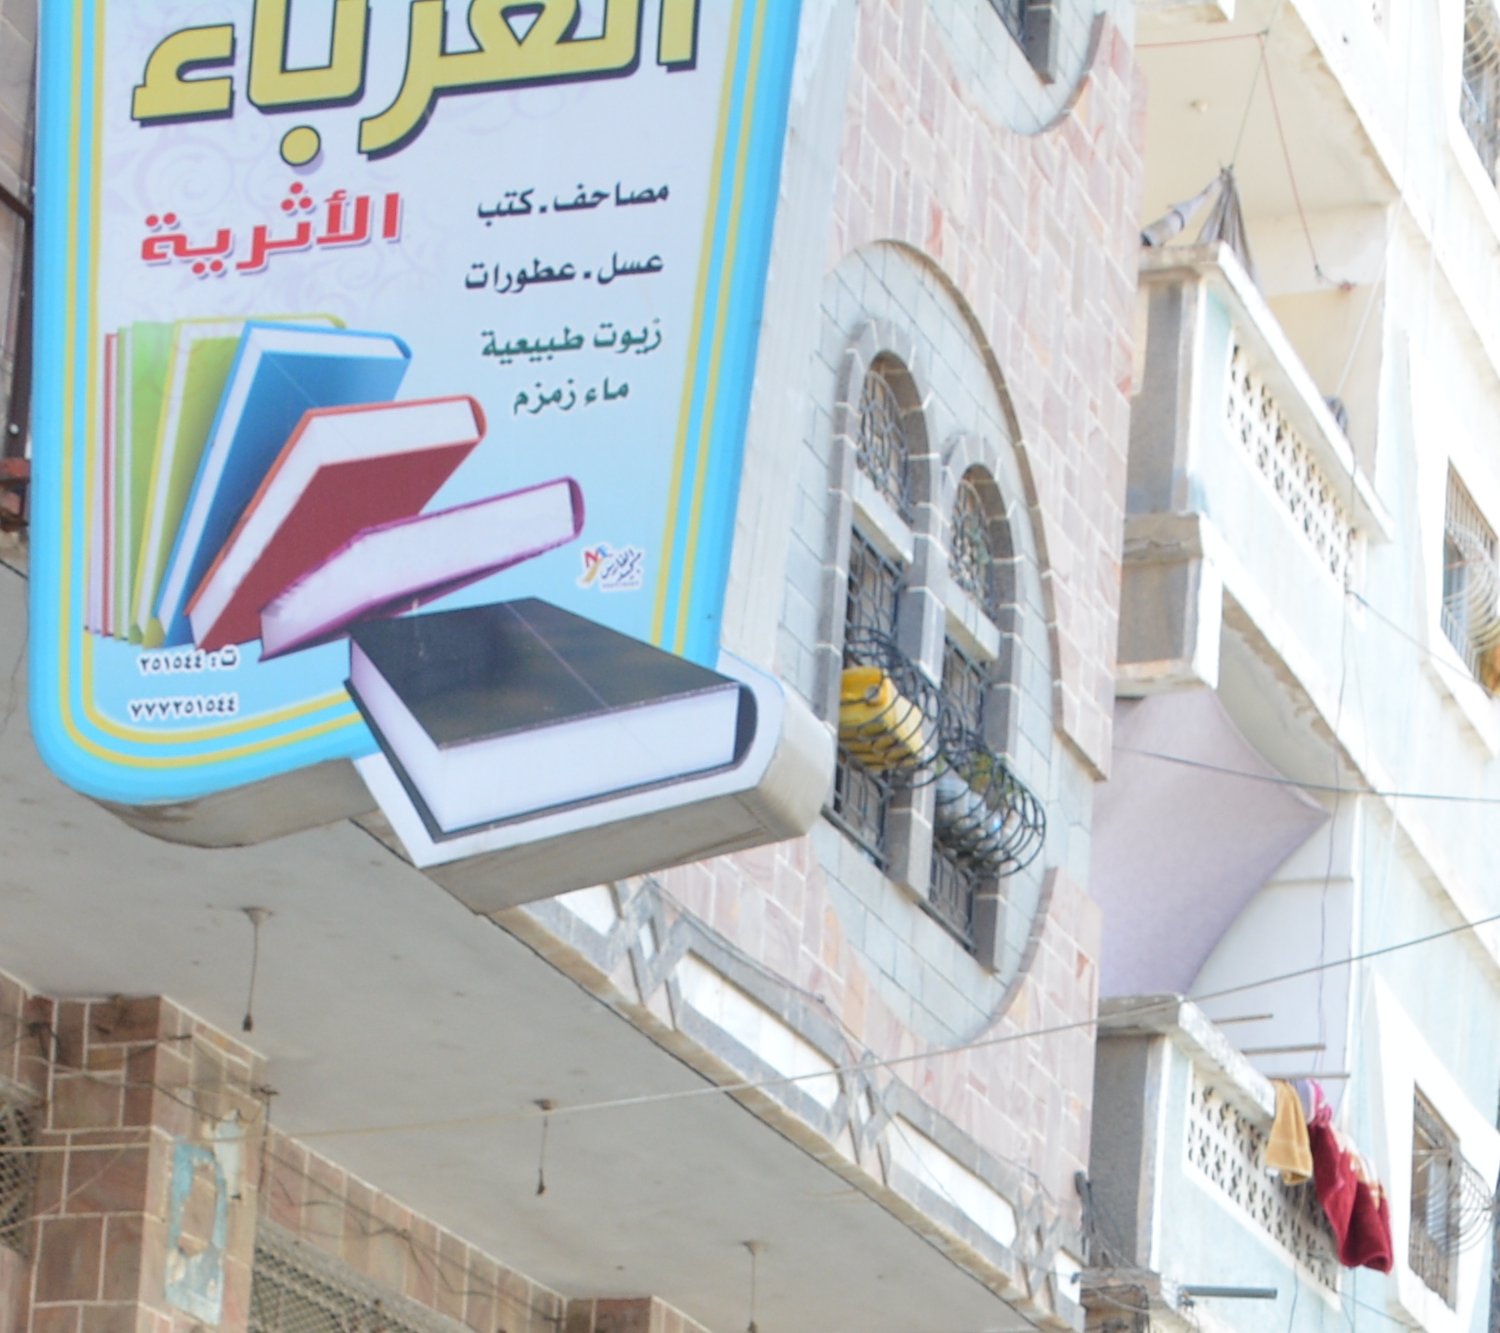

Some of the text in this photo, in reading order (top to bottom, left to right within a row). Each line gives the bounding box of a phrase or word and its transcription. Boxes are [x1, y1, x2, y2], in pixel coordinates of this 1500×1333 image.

[476, 181, 670, 228] مصاحف كتب
[141, 181, 402, 277] الأثرية
[464, 252, 665, 293] عسل عطورات
[480, 317, 663, 366] زيوت طبيعية
[512, 377, 630, 414] ماء زمزم
